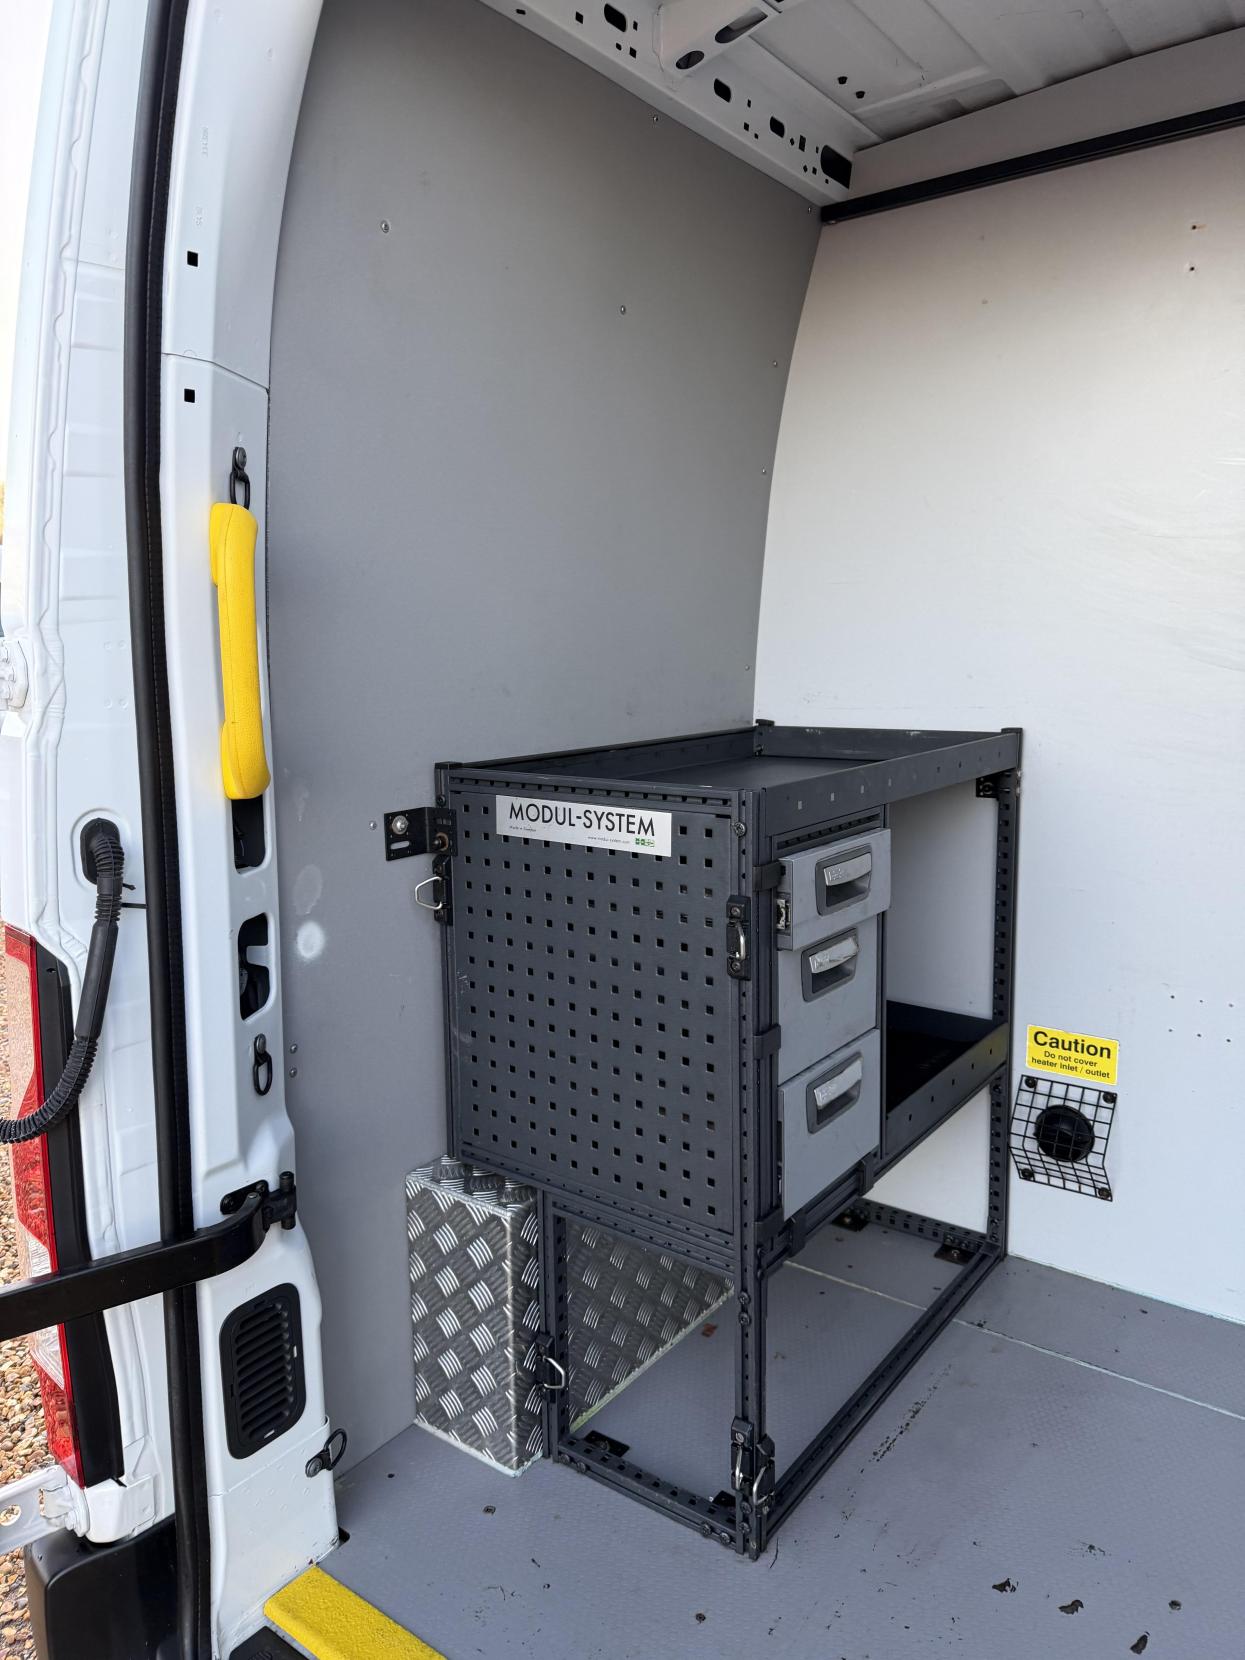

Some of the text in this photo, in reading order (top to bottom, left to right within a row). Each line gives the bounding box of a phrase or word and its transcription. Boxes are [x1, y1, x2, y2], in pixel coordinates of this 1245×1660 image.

[509, 802, 655, 837] MODUL-SYSTEM
[1033, 1031, 1111, 1059] Caution
[1031, 1056, 1057, 1068] heater
[1060, 1062, 1078, 1073] inlet
[1085, 1067, 1110, 1079] outlet
[1044, 1050, 1098, 1067] Do not cover
